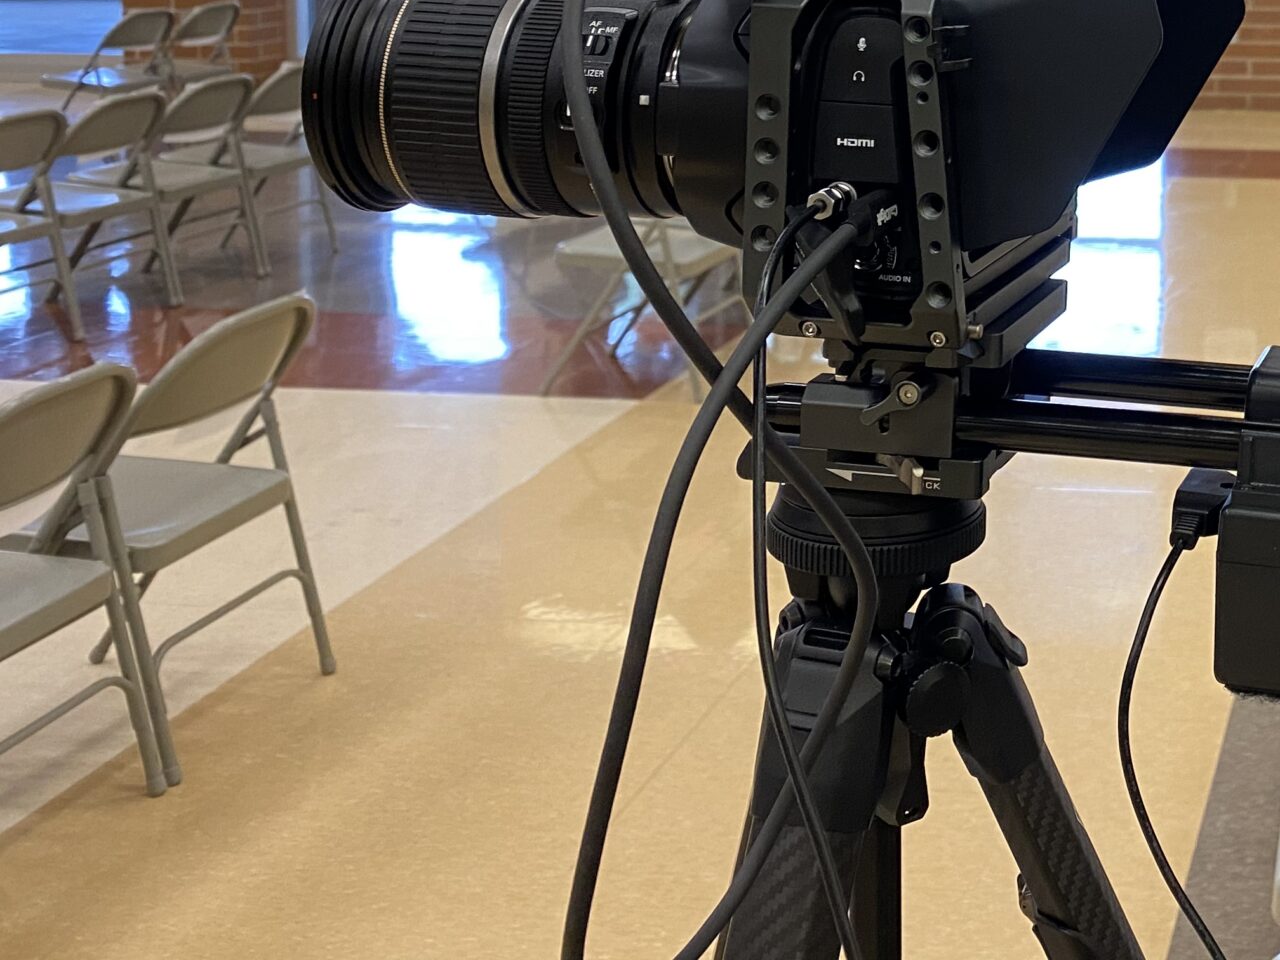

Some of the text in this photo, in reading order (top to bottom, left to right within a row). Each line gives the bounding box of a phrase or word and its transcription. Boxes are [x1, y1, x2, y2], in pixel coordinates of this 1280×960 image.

[604, 26, 620, 34] MF
[836, 137, 875, 148] HDMI
[878, 274, 902, 283] AUDIO
